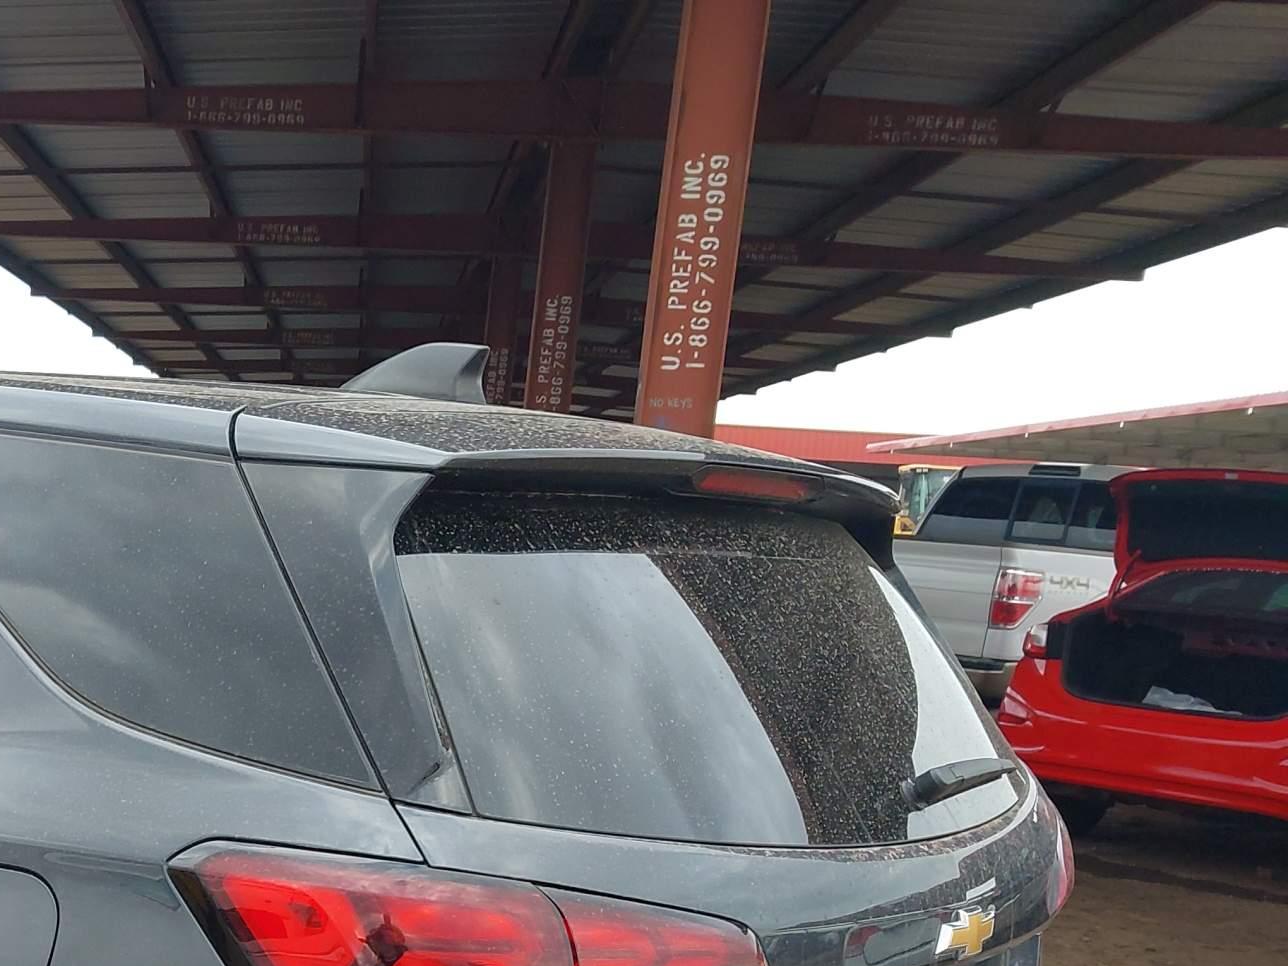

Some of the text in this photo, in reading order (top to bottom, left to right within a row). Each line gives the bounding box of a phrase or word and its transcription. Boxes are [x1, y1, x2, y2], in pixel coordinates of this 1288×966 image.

[537, 328, 554, 383] PREFAB
[660, 152, 706, 371] U.S. PREFAB INC.
[685, 154, 730, 368] 1-866-799-0969
